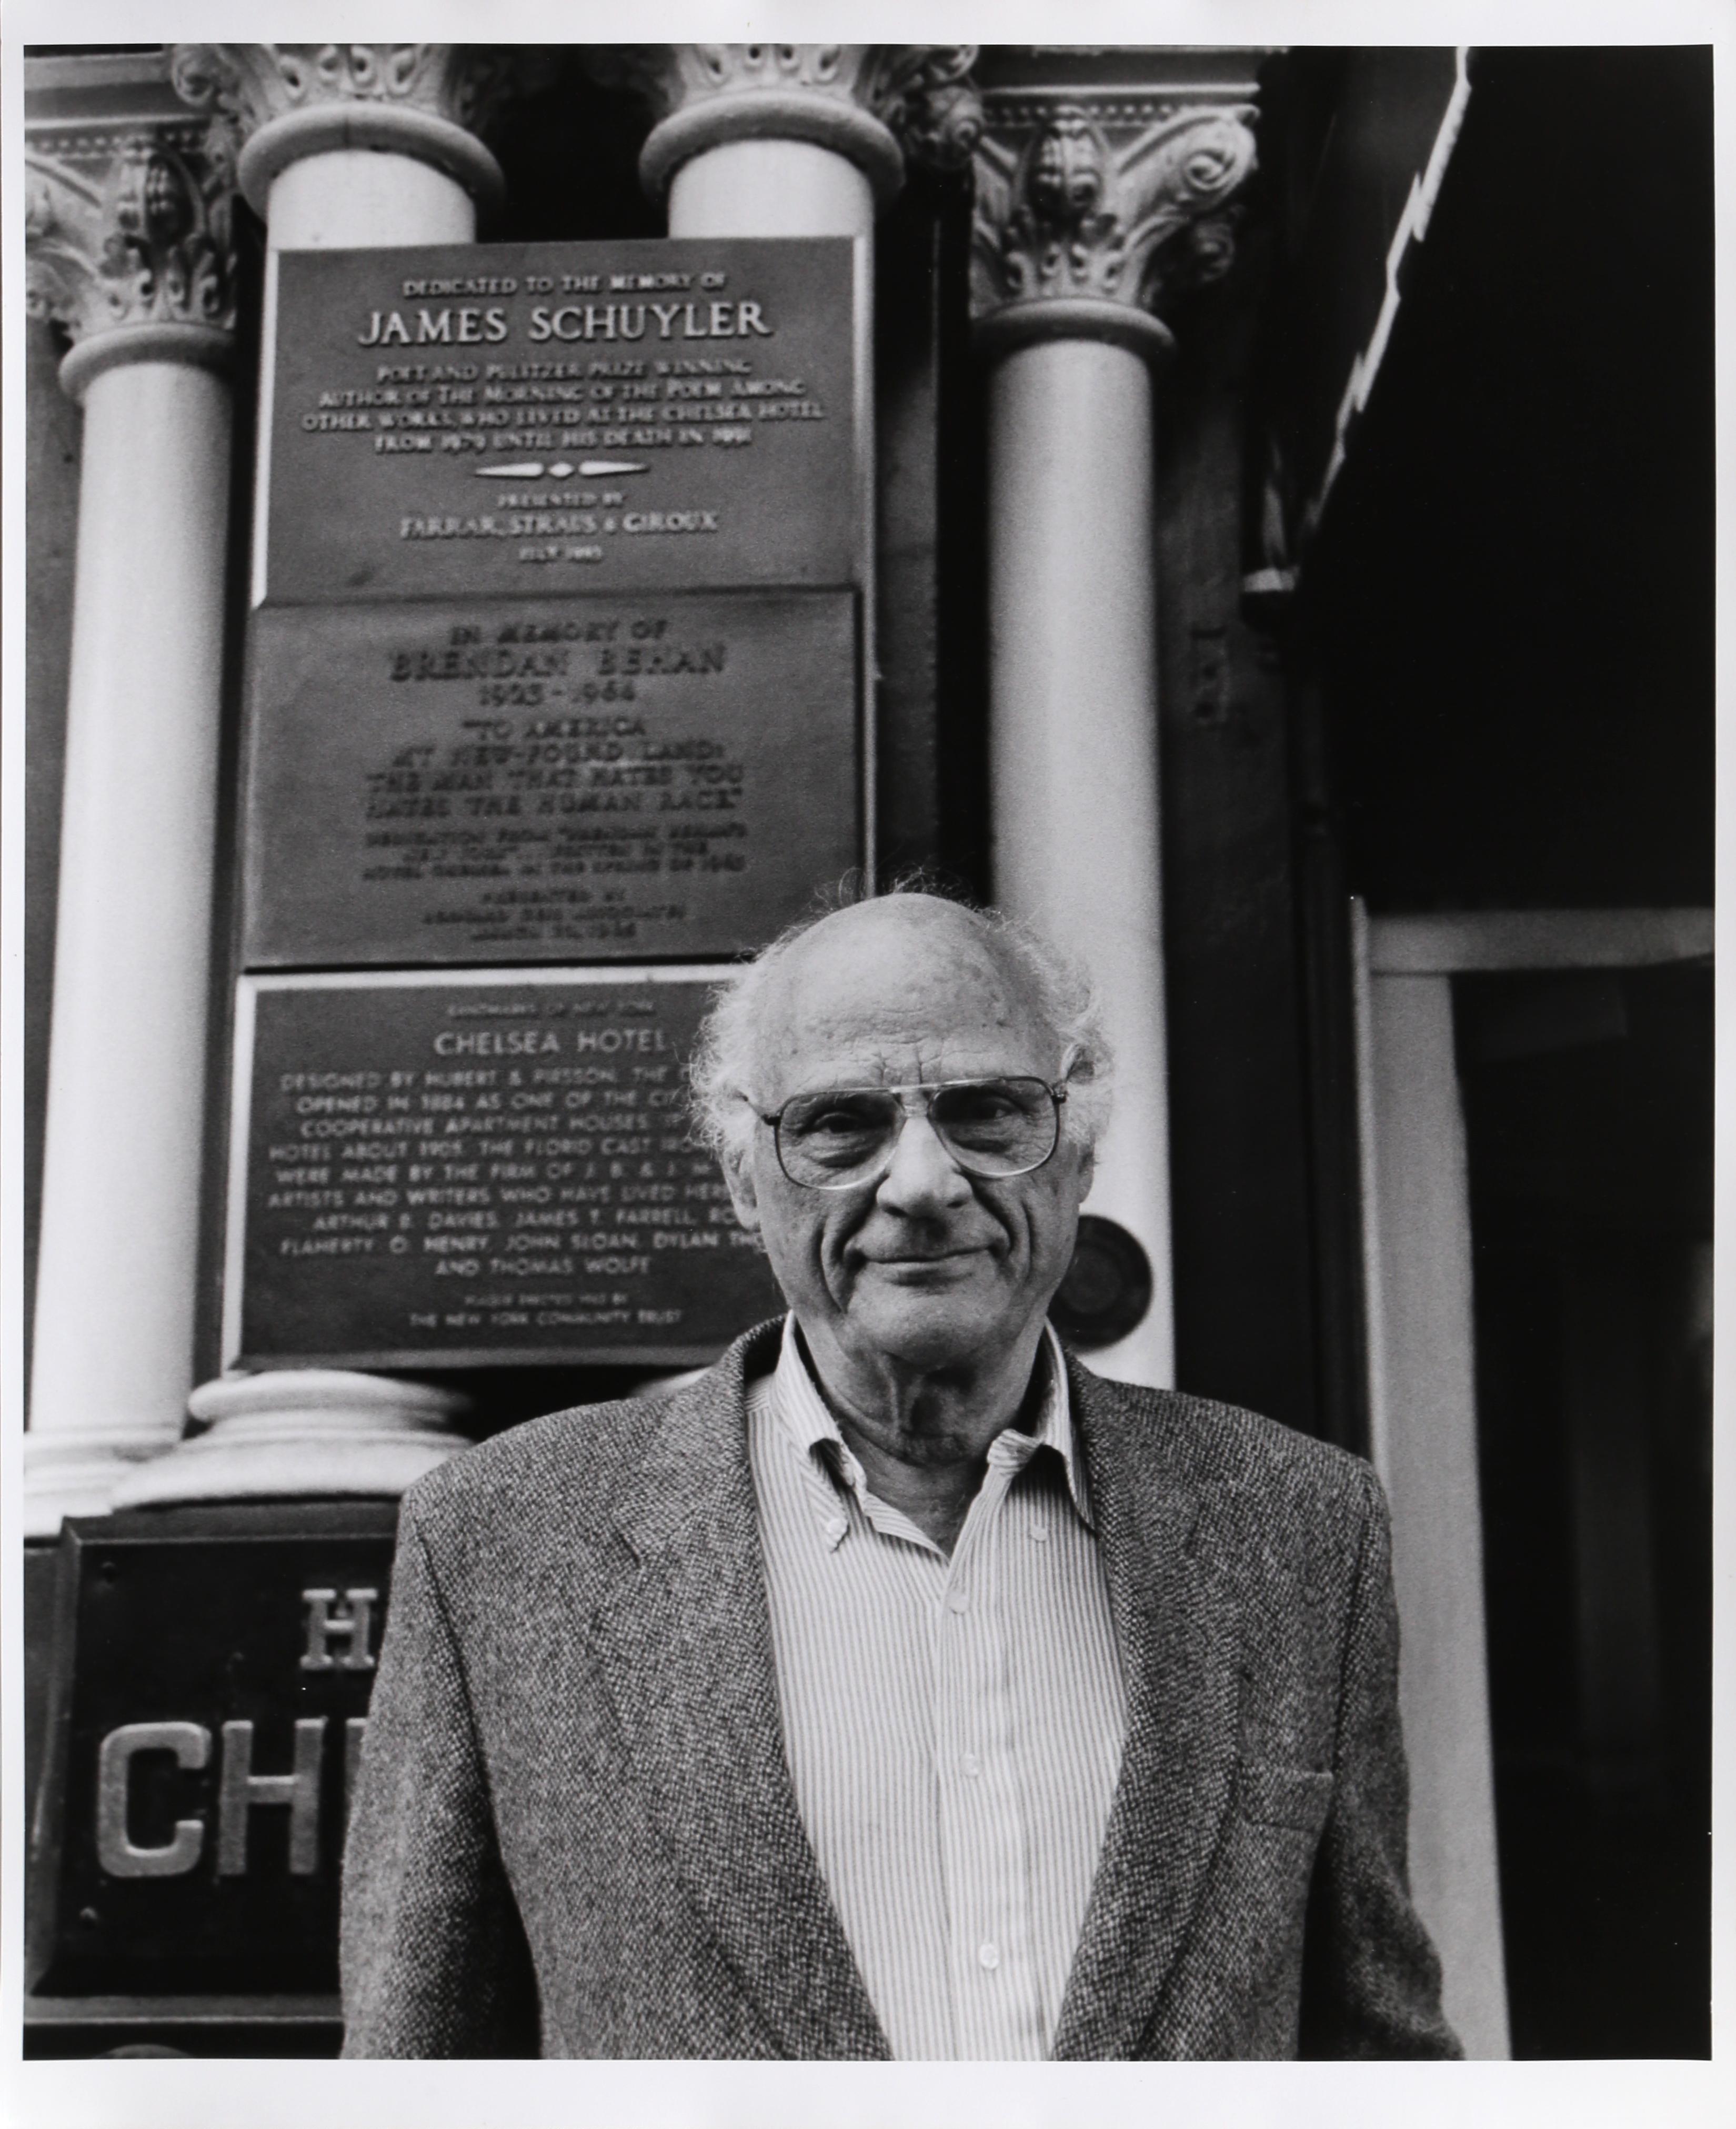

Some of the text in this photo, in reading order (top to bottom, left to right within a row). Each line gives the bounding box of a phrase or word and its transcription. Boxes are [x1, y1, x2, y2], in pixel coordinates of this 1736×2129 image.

[404, 272, 726, 297] DEDICATED TO THE MEMORY OF
[358, 301, 774, 345] JAMES SCHUYLER
[431, 364, 479, 382] AND
[319, 389, 402, 408] AUTHOR
[406, 388, 429, 406] OF
[438, 385, 477, 405] THE
[589, 384, 614, 402] OF
[623, 383, 659, 401] THE
[666, 378, 723, 399] POEM
[302, 413, 373, 431] OTHER
[661, 403, 752, 423] CHELSEA
[758, 400, 826, 421] HOTEL
[375, 435, 432, 453] FROM
[679, 428, 705, 447] IN
[623, 510, 719, 534] GIROUX
[450, 619, 669, 645] IN MEMORY OF
[388, 641, 727, 682] BRENDAN BEHAN
[525, 718, 646, 738] AMERICA
[433, 1028, 666, 1056] CHELSEA HOTEL
[280, 1070, 382, 1092] DESIGNED
[390, 1070, 416, 1089] BY
[424, 1069, 497, 1088] HUBERT
[630, 1064, 668, 1083] THE
[296, 1094, 378, 1114] OPENED
[387, 1094, 410, 1111] IN
[475, 1092, 501, 1110] AS
[509, 1091, 554, 1110] ONE
[565, 1090, 592, 1109] OF
[604, 1089, 638, 1107] THE
[300, 1117, 434, 1138] COOPERATIVE
[444, 1114, 558, 1134] APARTMENT
[267, 1142, 332, 1162] HOTEL
[341, 1140, 408, 1160] ABOUT
[478, 1138, 514, 1157] THE
[524, 1137, 595, 1156] FLORID
[600, 1136, 651, 1156] CAST
[275, 1167, 330, 1185] WERE
[342, 1164, 398, 1183] MADE
[408, 1163, 433, 1182] BY
[444, 1163, 479, 1181] THE
[490, 1162, 537, 1180] FIRM
[546, 1161, 573, 1179] OF
[268, 1190, 344, 1209] ARTISTS
[354, 1188, 398, 1207] AND
[406, 1187, 490, 1206] WRITERS
[500, 1184, 552, 1203] WHO
[559, 1184, 610, 1203] HAVE
[621, 1184, 676, 1202] LIVED
[312, 1212, 389, 1231] ARTHUR
[515, 1208, 579, 1228] JAMES
[504, 1232, 561, 1252] JOHN
[653, 1230, 720, 1250] DYLAN
[434, 1254, 652, 1277] AND THOMAS WOLFE
[444, 1311, 481, 1327] NEW
[489, 1310, 529, 1327] YORK
[535, 1309, 631, 1327] COMMUNITY
[637, 1308, 683, 1327] TRUST
[301, 1588, 378, 1670] H
[98, 1719, 369, 1877] CH
